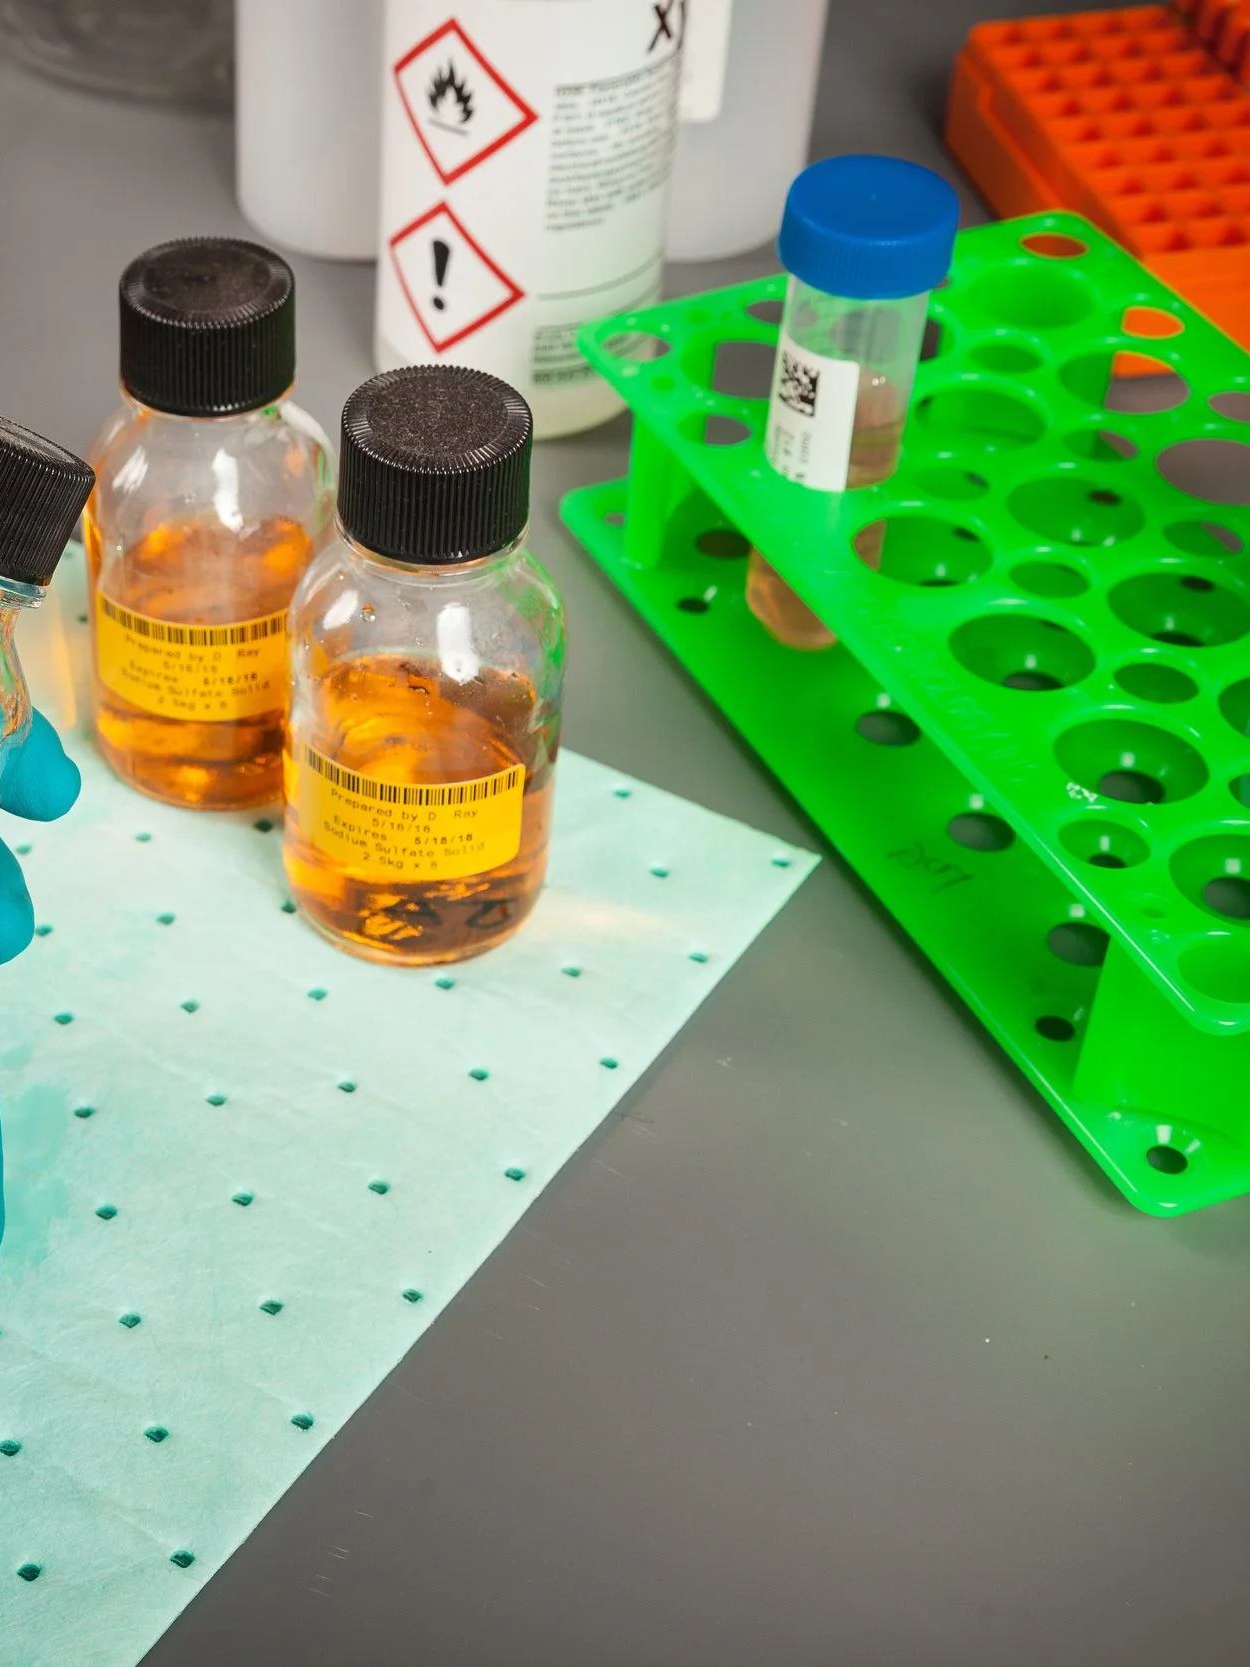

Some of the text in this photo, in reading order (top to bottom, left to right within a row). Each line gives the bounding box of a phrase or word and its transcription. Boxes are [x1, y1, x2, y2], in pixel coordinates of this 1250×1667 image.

[331, 788, 392, 817] Prepared
[401, 810, 418, 822] by
[324, 820, 485, 858] Sodium Sulfate Solid
